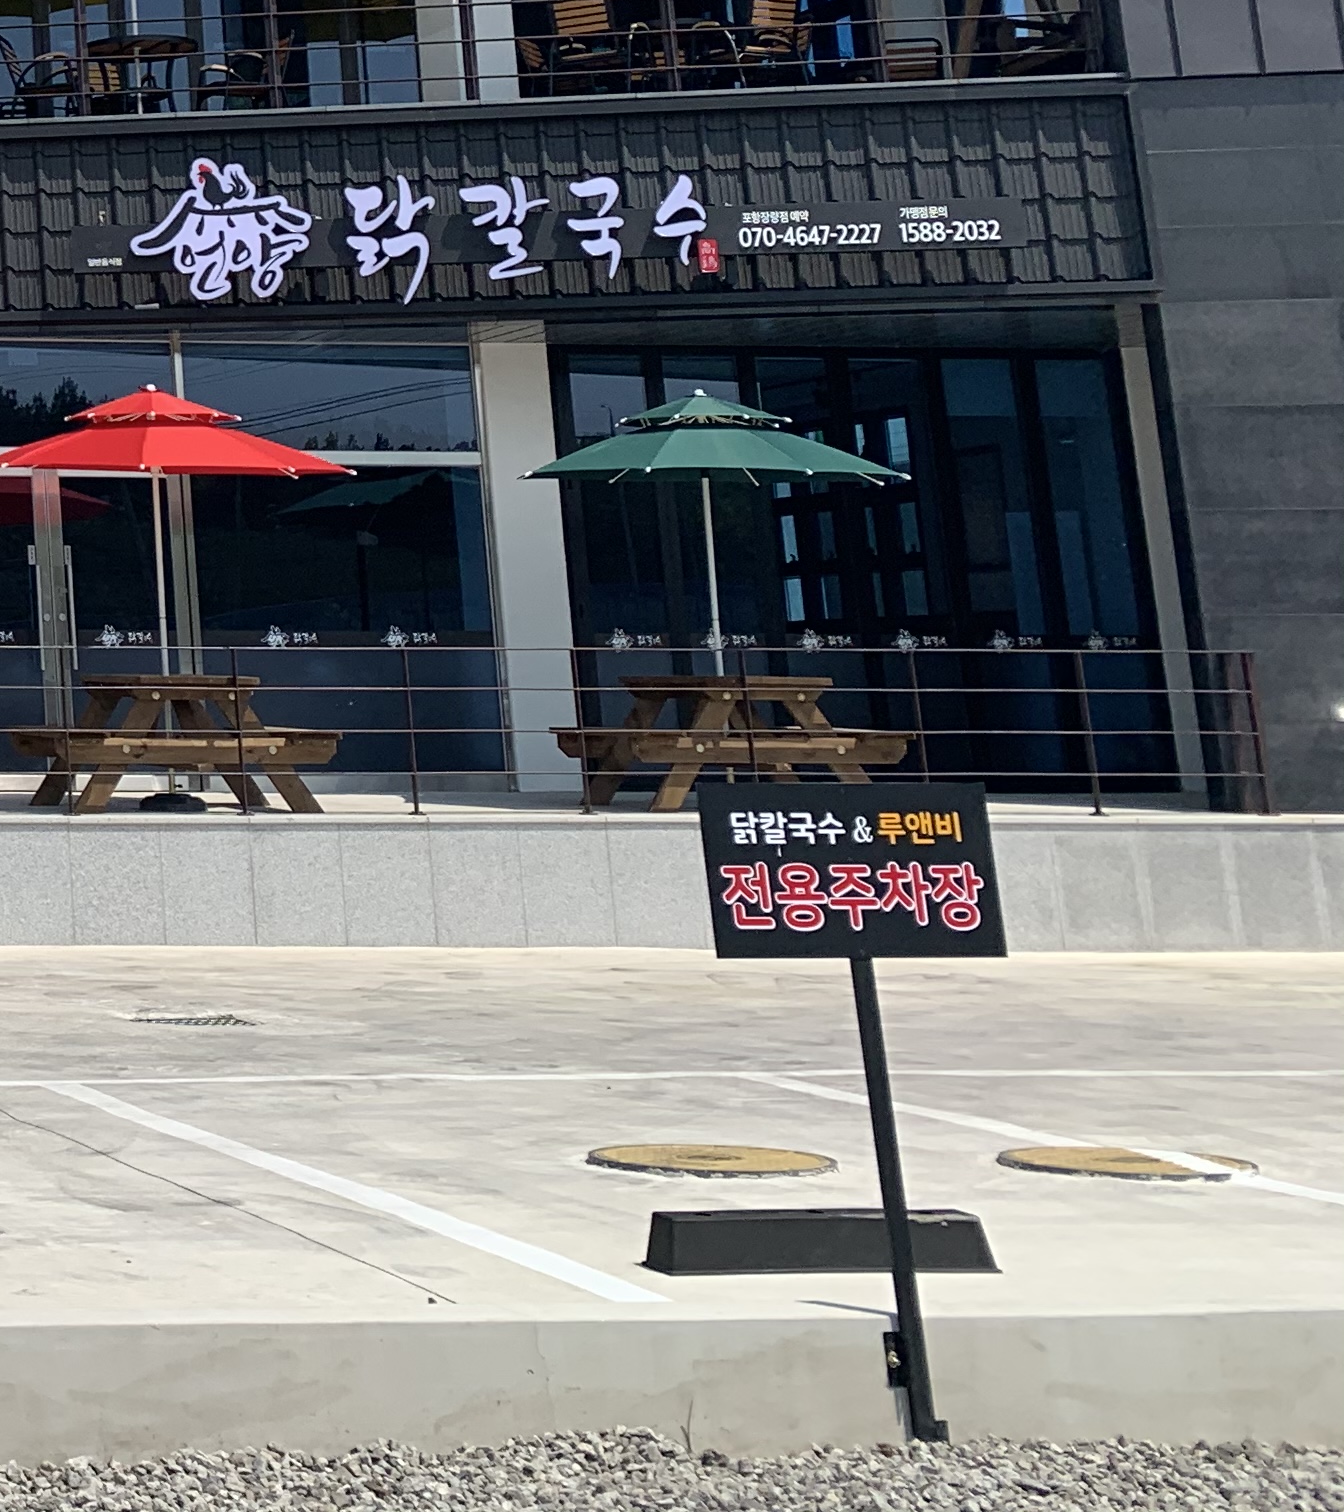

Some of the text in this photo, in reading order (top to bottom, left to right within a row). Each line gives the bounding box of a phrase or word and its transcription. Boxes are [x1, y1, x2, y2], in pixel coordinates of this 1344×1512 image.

[790, 210, 809, 224] 예약
[738, 223, 882, 248] 070-4647-2227
[899, 219, 1002, 244] 1588-2032
[728, 811, 964, 846] 닭칼국수 & 루앤비
[719, 860, 985, 932] 전용주차장
